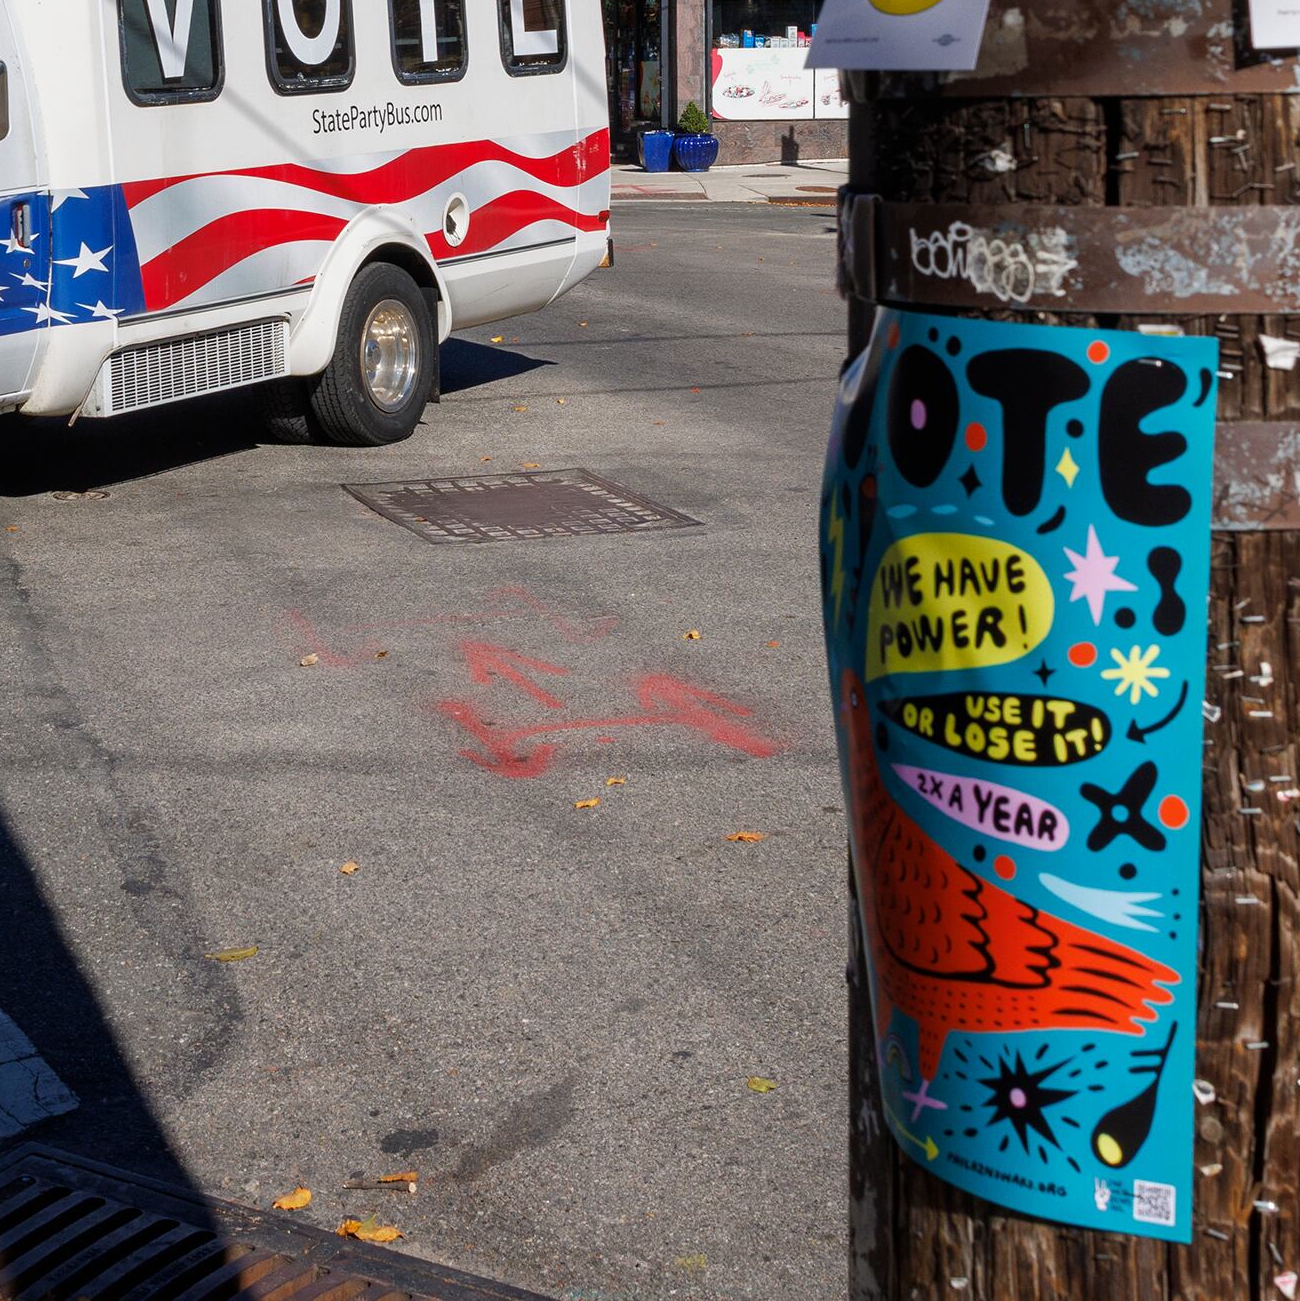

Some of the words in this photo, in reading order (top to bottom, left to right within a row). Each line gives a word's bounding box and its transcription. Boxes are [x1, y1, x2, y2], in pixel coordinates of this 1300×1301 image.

[312, 102, 443, 134] StatePartyBus.com
[881, 556, 923, 609] WE
[935, 554, 1026, 599] HAVE
[903, 703, 933, 736] OR
[945, 713, 1037, 762] LOSE
[1054, 717, 1103, 763] IT!
[966, 695, 1022, 726] USE
[1032, 699, 1076, 729] IT
[916, 773, 943, 800] 2X
[948, 784, 963, 812] A
[974, 784, 1058, 842] YEAR
